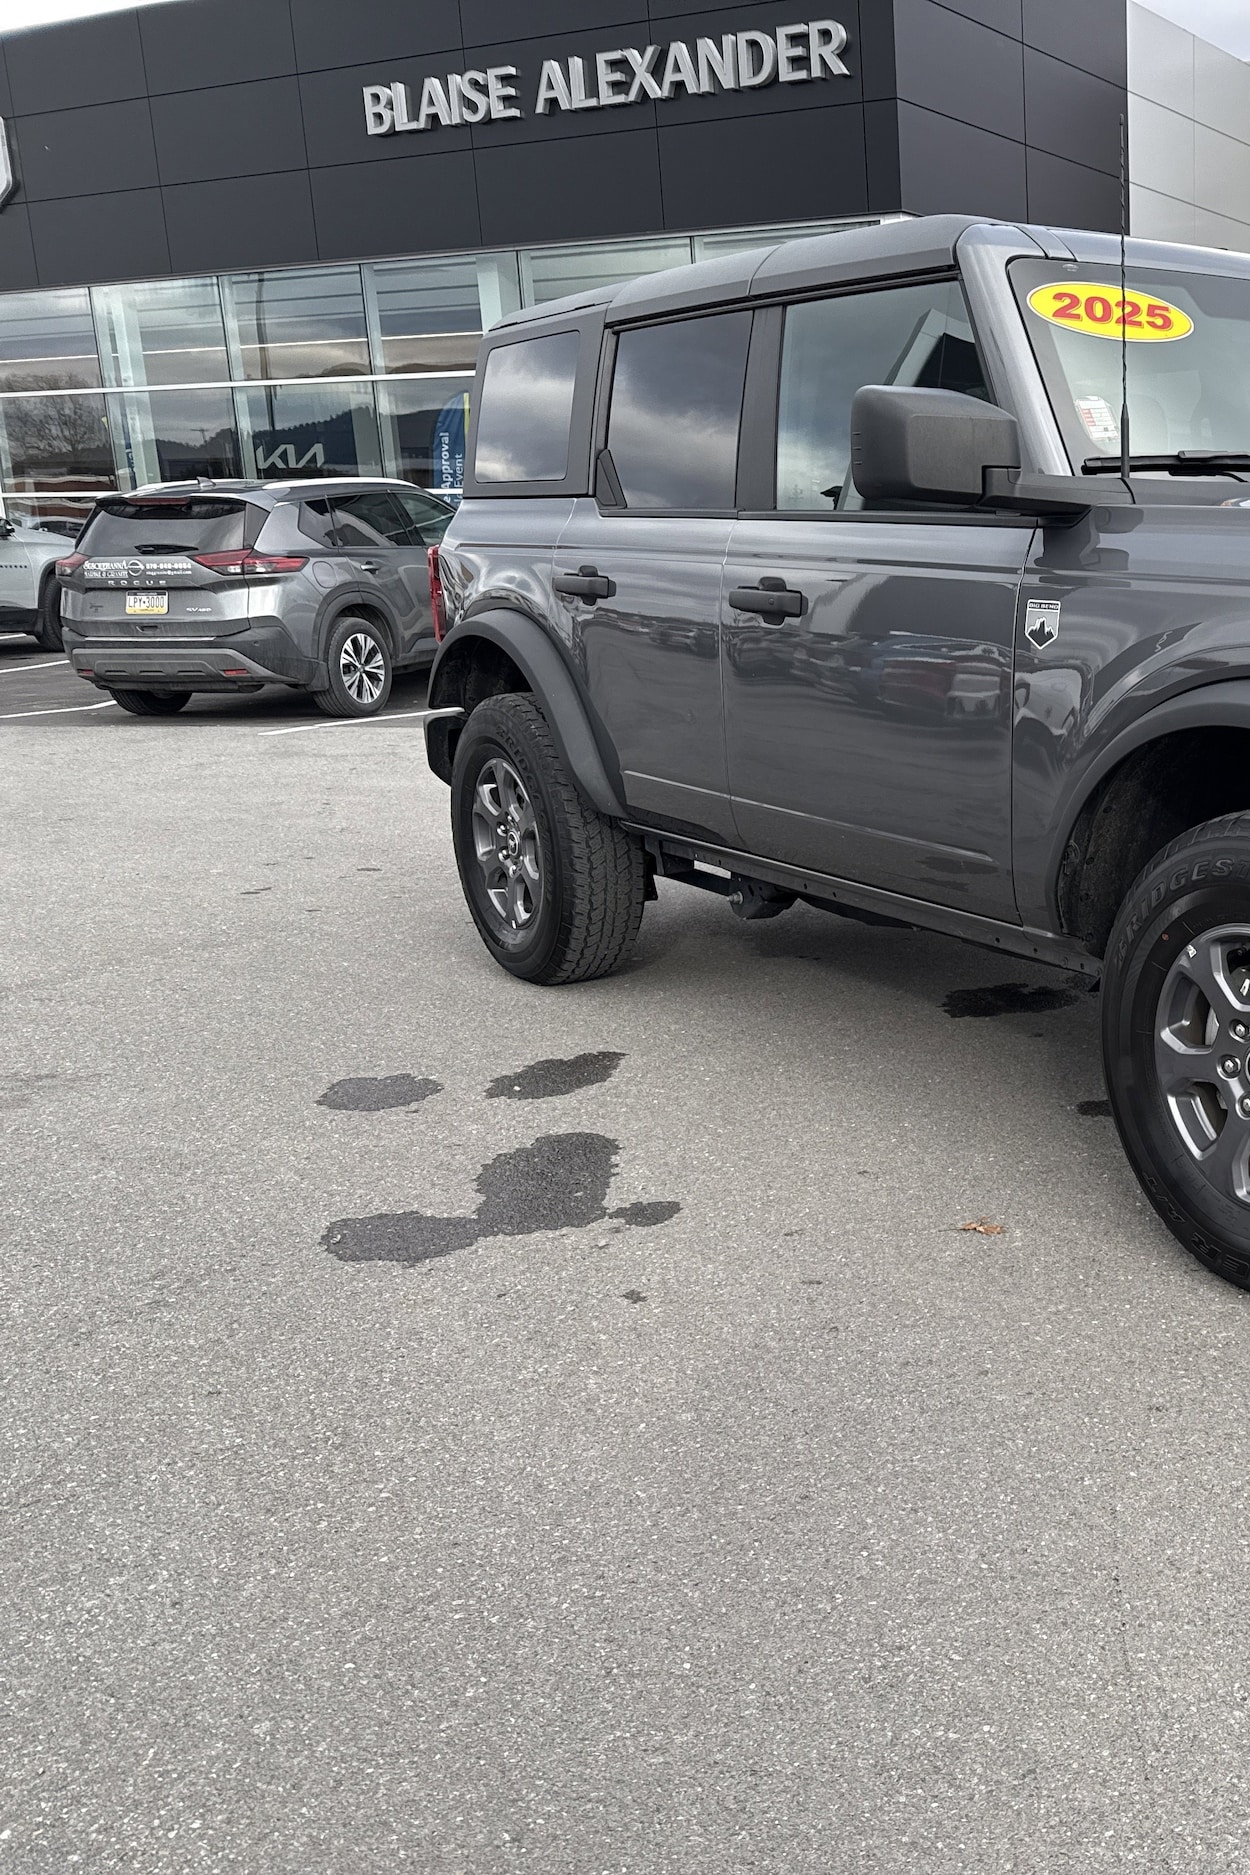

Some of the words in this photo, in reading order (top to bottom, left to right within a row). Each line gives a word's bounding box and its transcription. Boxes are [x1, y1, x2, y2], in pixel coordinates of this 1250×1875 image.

[362, 65, 521, 136] BLAISE
[534, 19, 850, 115] ALEXANDER
[1052, 292, 1173, 331] 2025
[256, 443, 325, 470] KIA
[454, 453, 464, 488] Event
